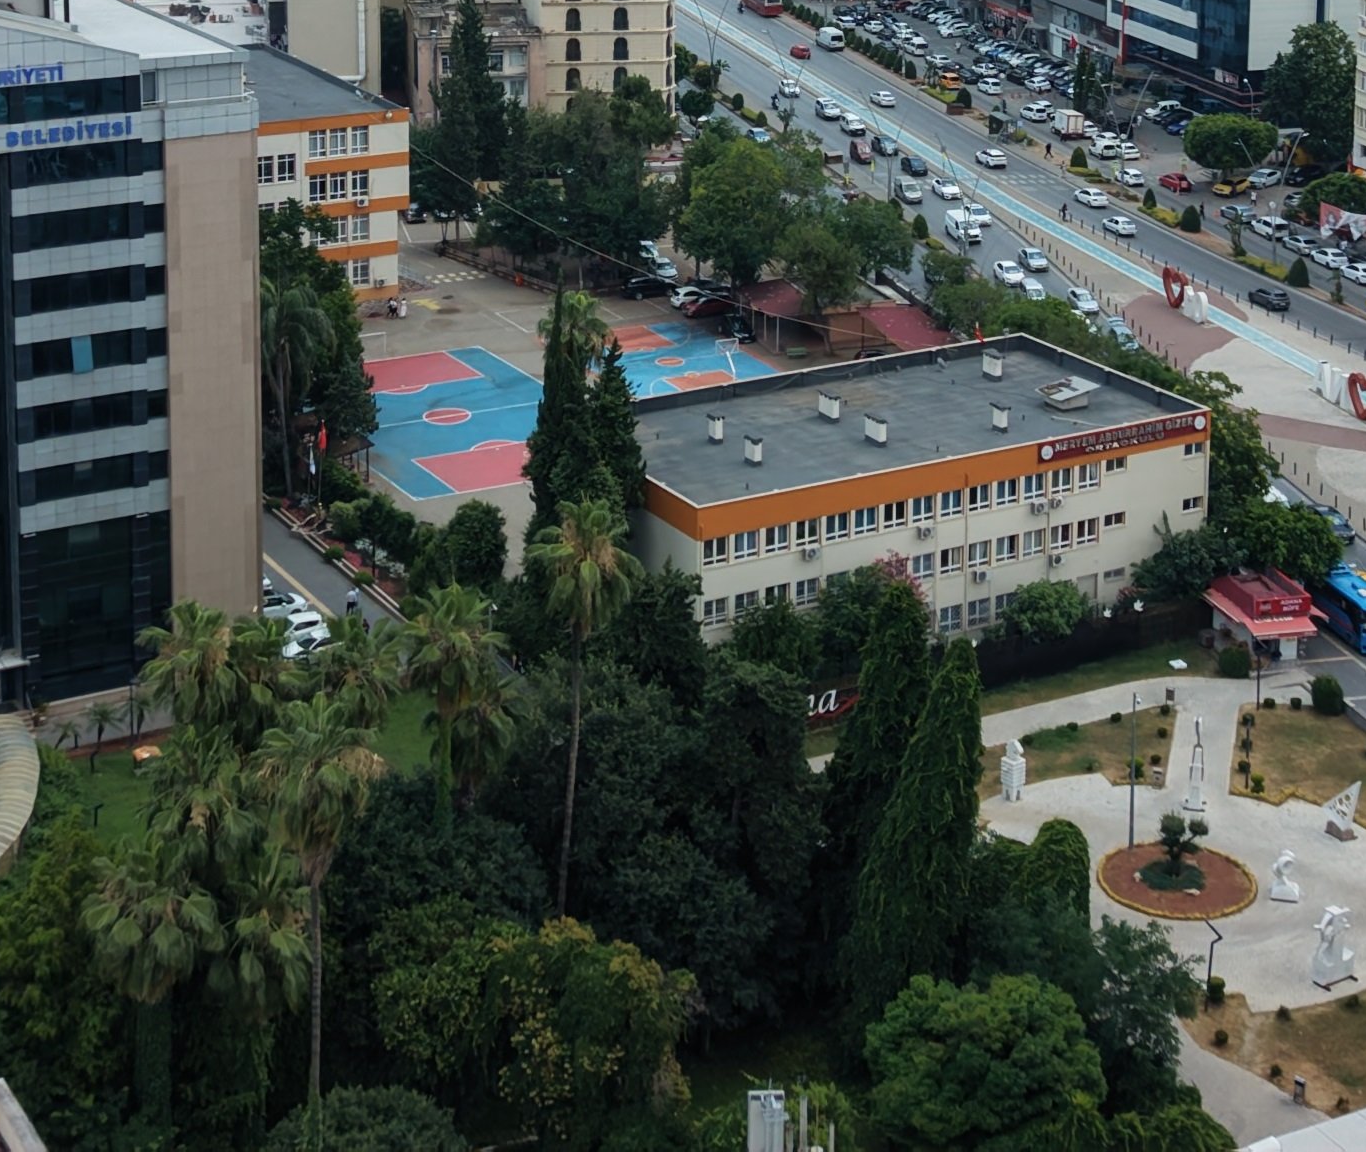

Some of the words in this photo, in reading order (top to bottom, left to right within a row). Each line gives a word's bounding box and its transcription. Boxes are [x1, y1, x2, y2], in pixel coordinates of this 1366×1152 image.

[6, 115, 133, 148] BELEDİYESİ
[1054, 435, 1097, 453] MERYEM
[1085, 432, 1164, 453] ORTAOKULU
